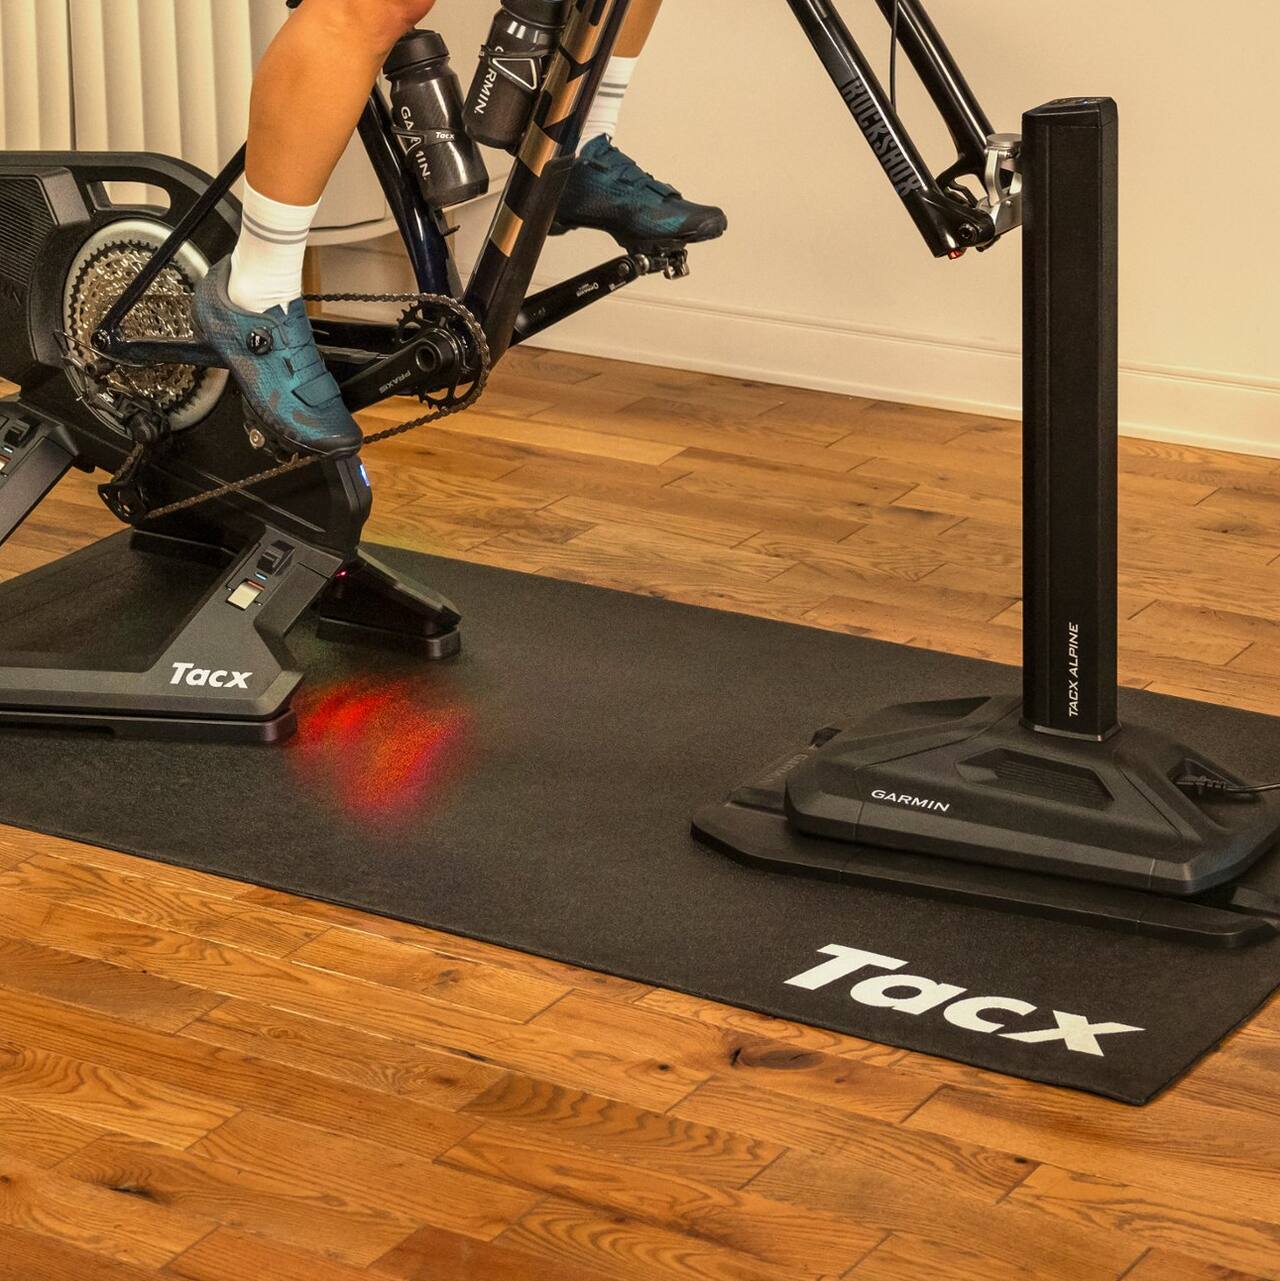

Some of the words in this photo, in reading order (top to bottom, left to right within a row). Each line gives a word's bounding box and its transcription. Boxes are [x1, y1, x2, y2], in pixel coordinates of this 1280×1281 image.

[435, 131, 455, 140] Tacx
[1068, 621, 1079, 678] ALPINE
[169, 661, 254, 689] Tacx
[1068, 679, 1079, 717] TACX
[871, 789, 950, 812] GARMIN
[783, 943, 1146, 1057] Tacx
